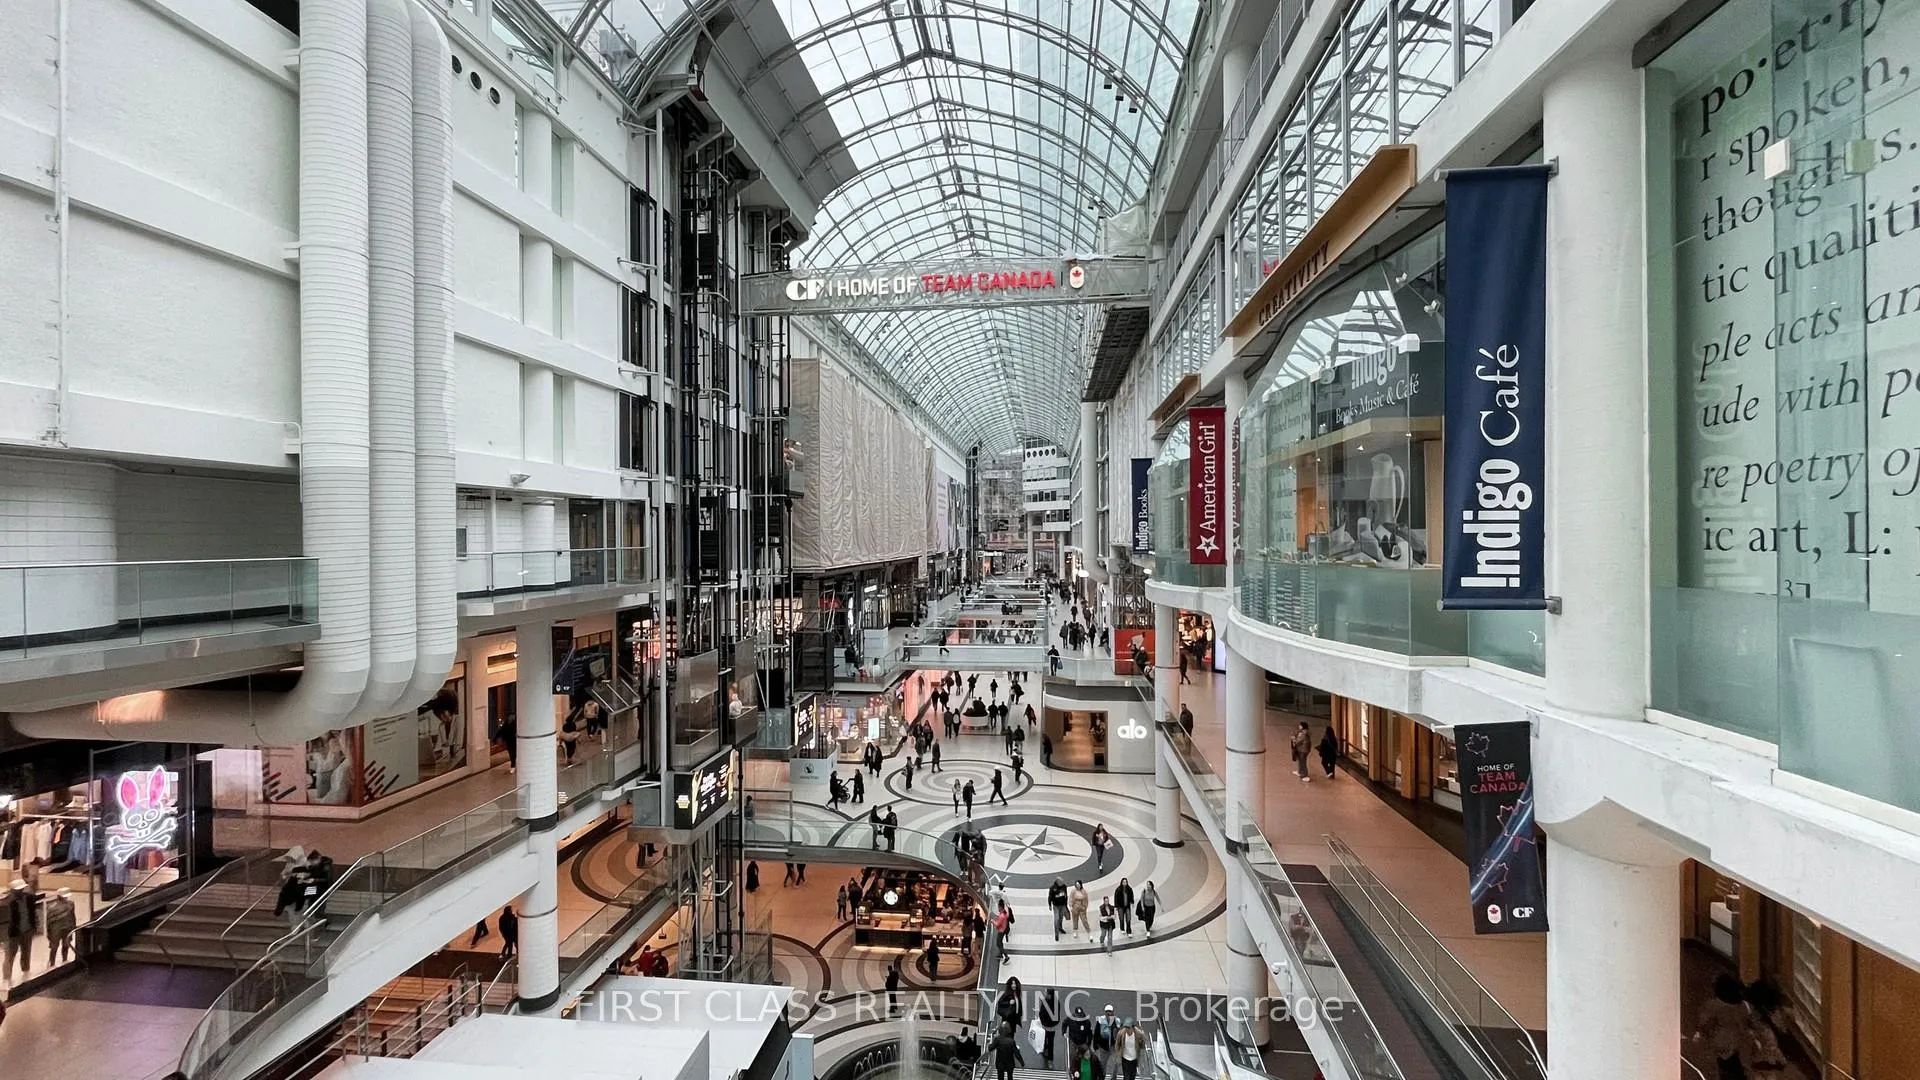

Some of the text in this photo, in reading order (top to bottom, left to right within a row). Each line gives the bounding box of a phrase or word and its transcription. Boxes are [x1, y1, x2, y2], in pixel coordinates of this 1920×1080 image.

[786, 270, 1056, 301] CF HOME OF TEAM CANADA
[1258, 240, 1330, 326] CREATIVITY
[1702, 263, 1749, 303] tic
[1700, 321, 1752, 384] ple
[1764, 305, 1842, 350] acts
[1359, 391, 1385, 416] Music
[1386, 386, 1396, 405] &
[1396, 373, 1419, 400] Café
[1702, 360, 1920, 428] ude with p
[1461, 344, 1532, 587] Indigo Café
[1702, 463, 1729, 489] re
[1741, 452, 1865, 503] poetry
[1136, 489, 1150, 550] Indigo Books
[1703, 511, 1891, 564] ic art, L:
[1117, 718, 1148, 739] alo
[1470, 782, 1528, 794] CANADA
[1477, 763, 1515, 772] HOME OF
[1478, 771, 1516, 782] TEAM
[1512, 907, 1535, 918] CF
